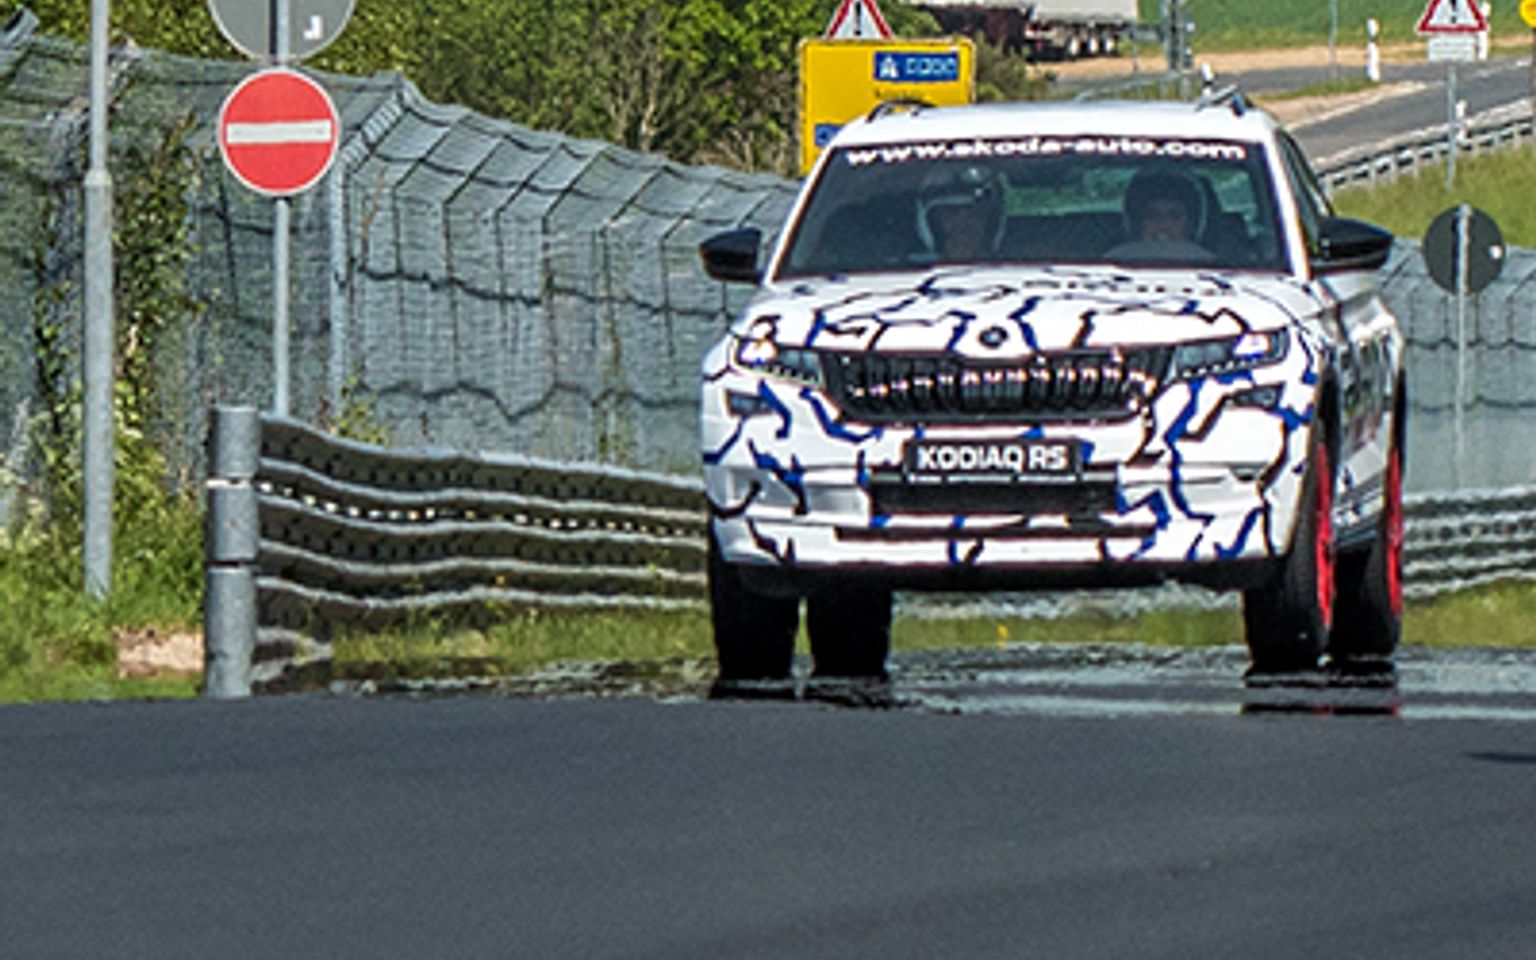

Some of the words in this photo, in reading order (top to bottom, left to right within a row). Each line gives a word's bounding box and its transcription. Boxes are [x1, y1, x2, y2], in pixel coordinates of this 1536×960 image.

[845, 136, 1247, 165] www.skoda-auto.com
[917, 444, 1024, 473] KODIAQ
[1028, 444, 1068, 471] RS
